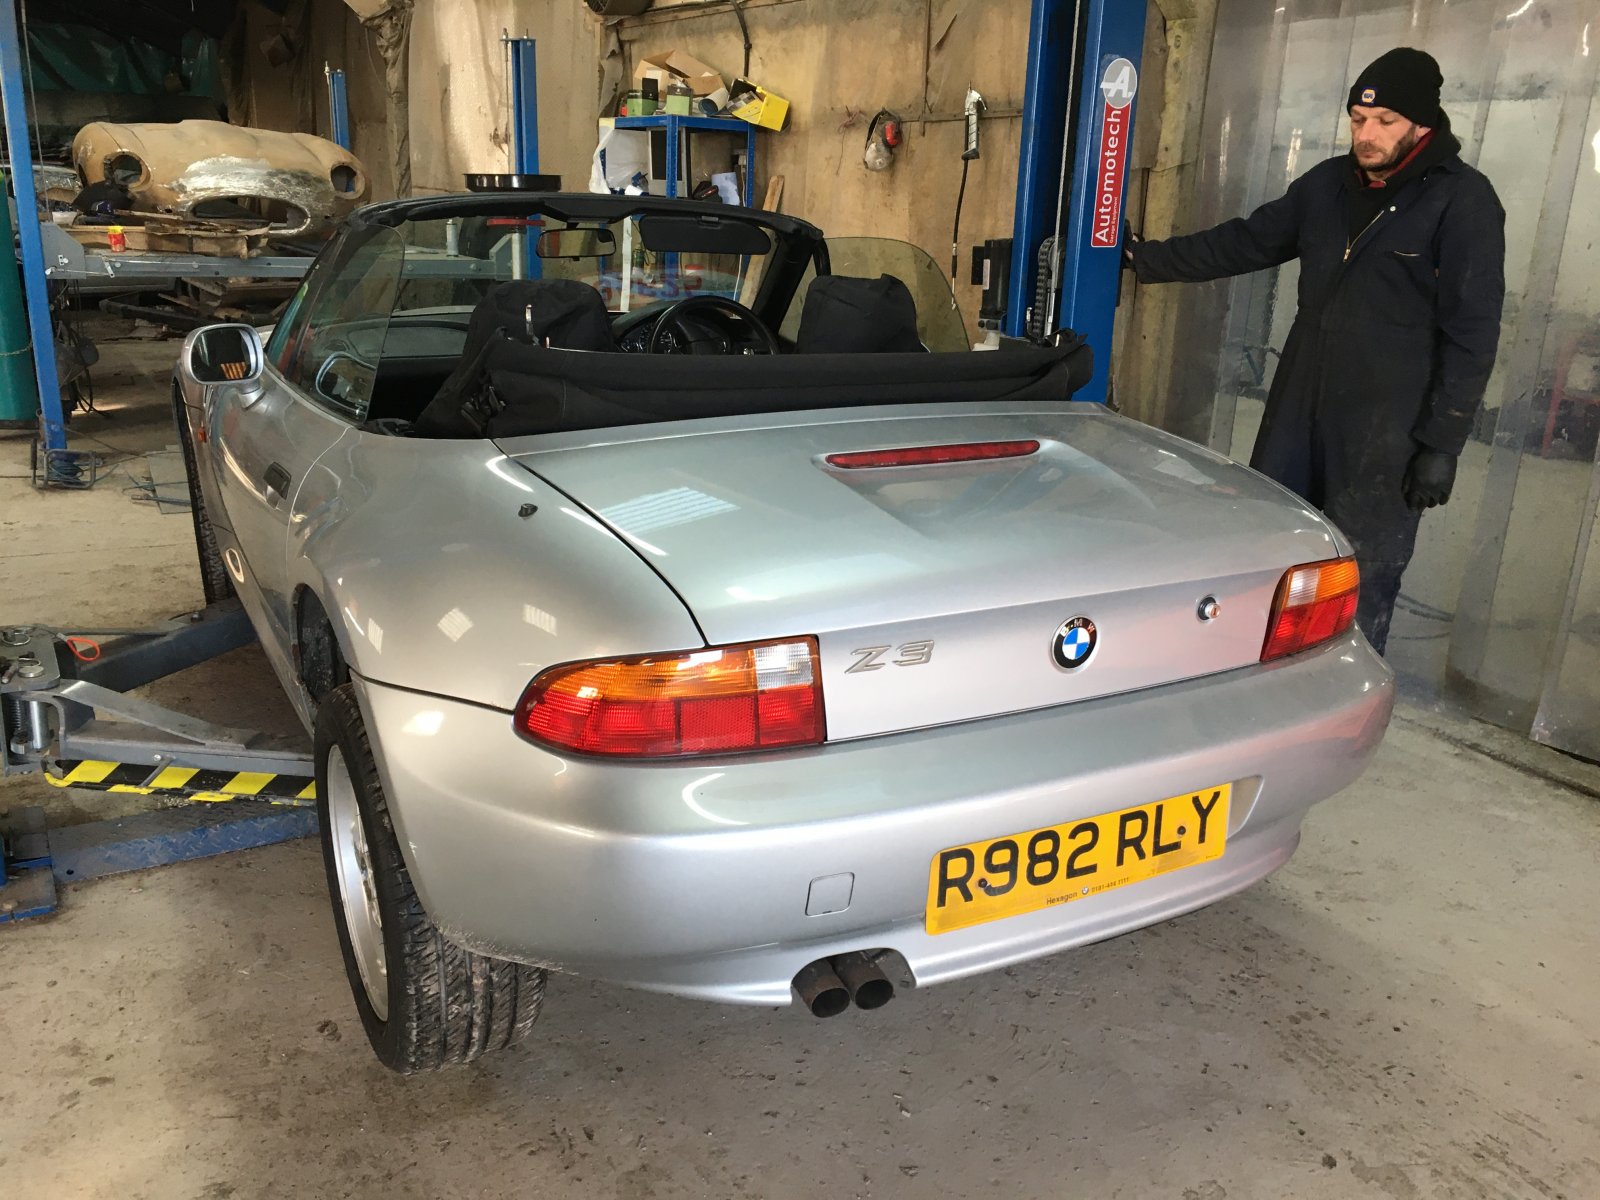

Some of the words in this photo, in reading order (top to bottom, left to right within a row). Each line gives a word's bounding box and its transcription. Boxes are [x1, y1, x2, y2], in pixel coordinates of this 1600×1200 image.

[1095, 108, 1122, 243] Automotech
[844, 640, 935, 675] Z3
[936, 821, 1100, 908] R982
[1116, 791, 1222, 867] RLY
[1046, 892, 1078, 905] Hexagon
